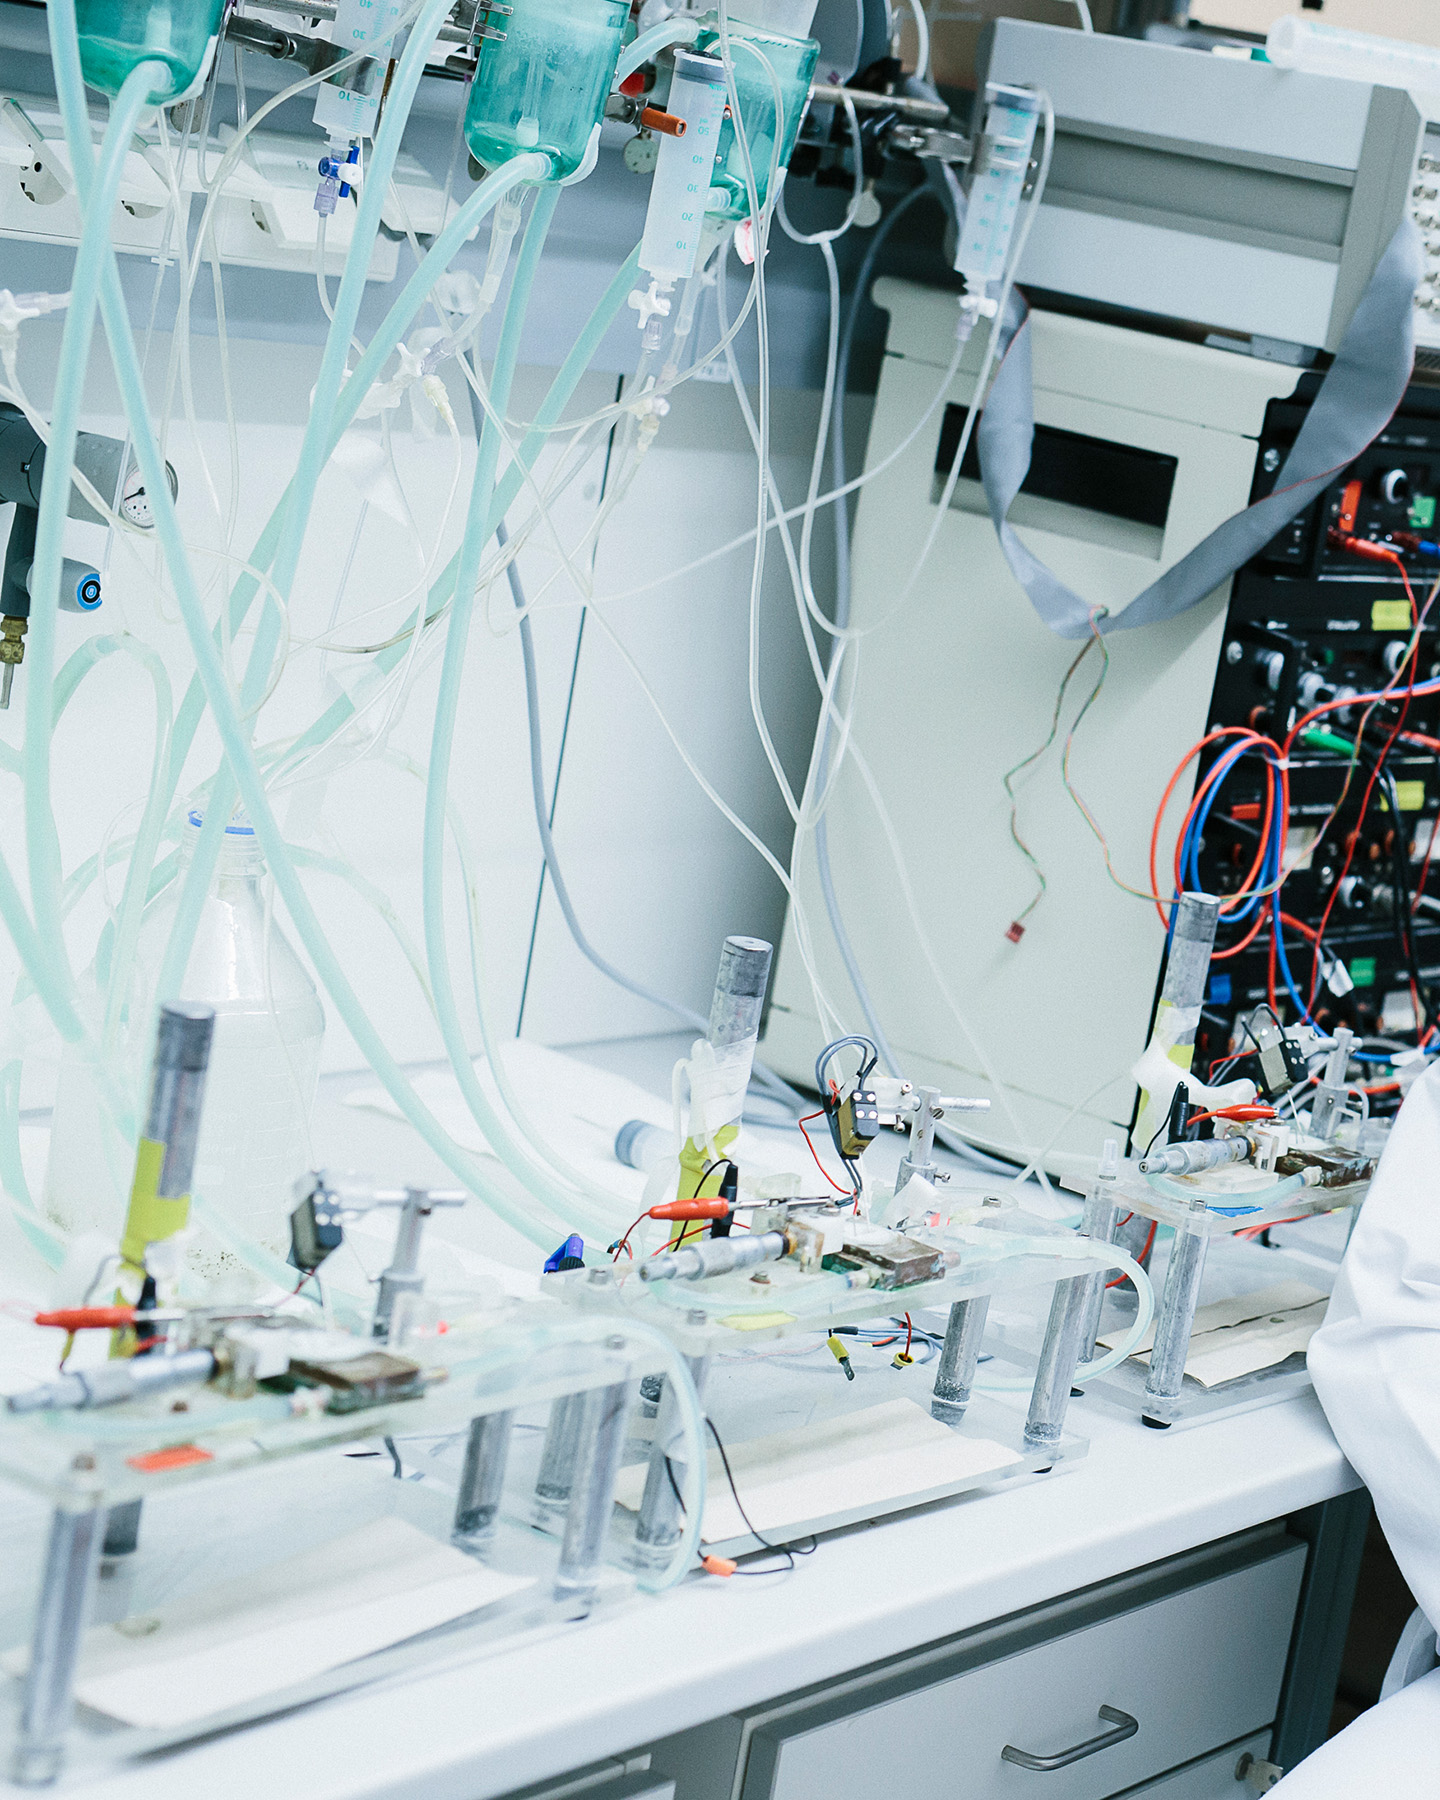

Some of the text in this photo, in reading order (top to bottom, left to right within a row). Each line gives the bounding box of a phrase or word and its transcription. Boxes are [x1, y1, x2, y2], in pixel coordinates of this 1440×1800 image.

[352, 28, 367, 40] 30
[338, 90, 351, 101] 10
[697, 126, 710, 136] 50
[692, 154, 704, 165] 40
[686, 183, 699, 193] 30
[681, 212, 694, 222] 20
[676, 240, 688, 250] 10
